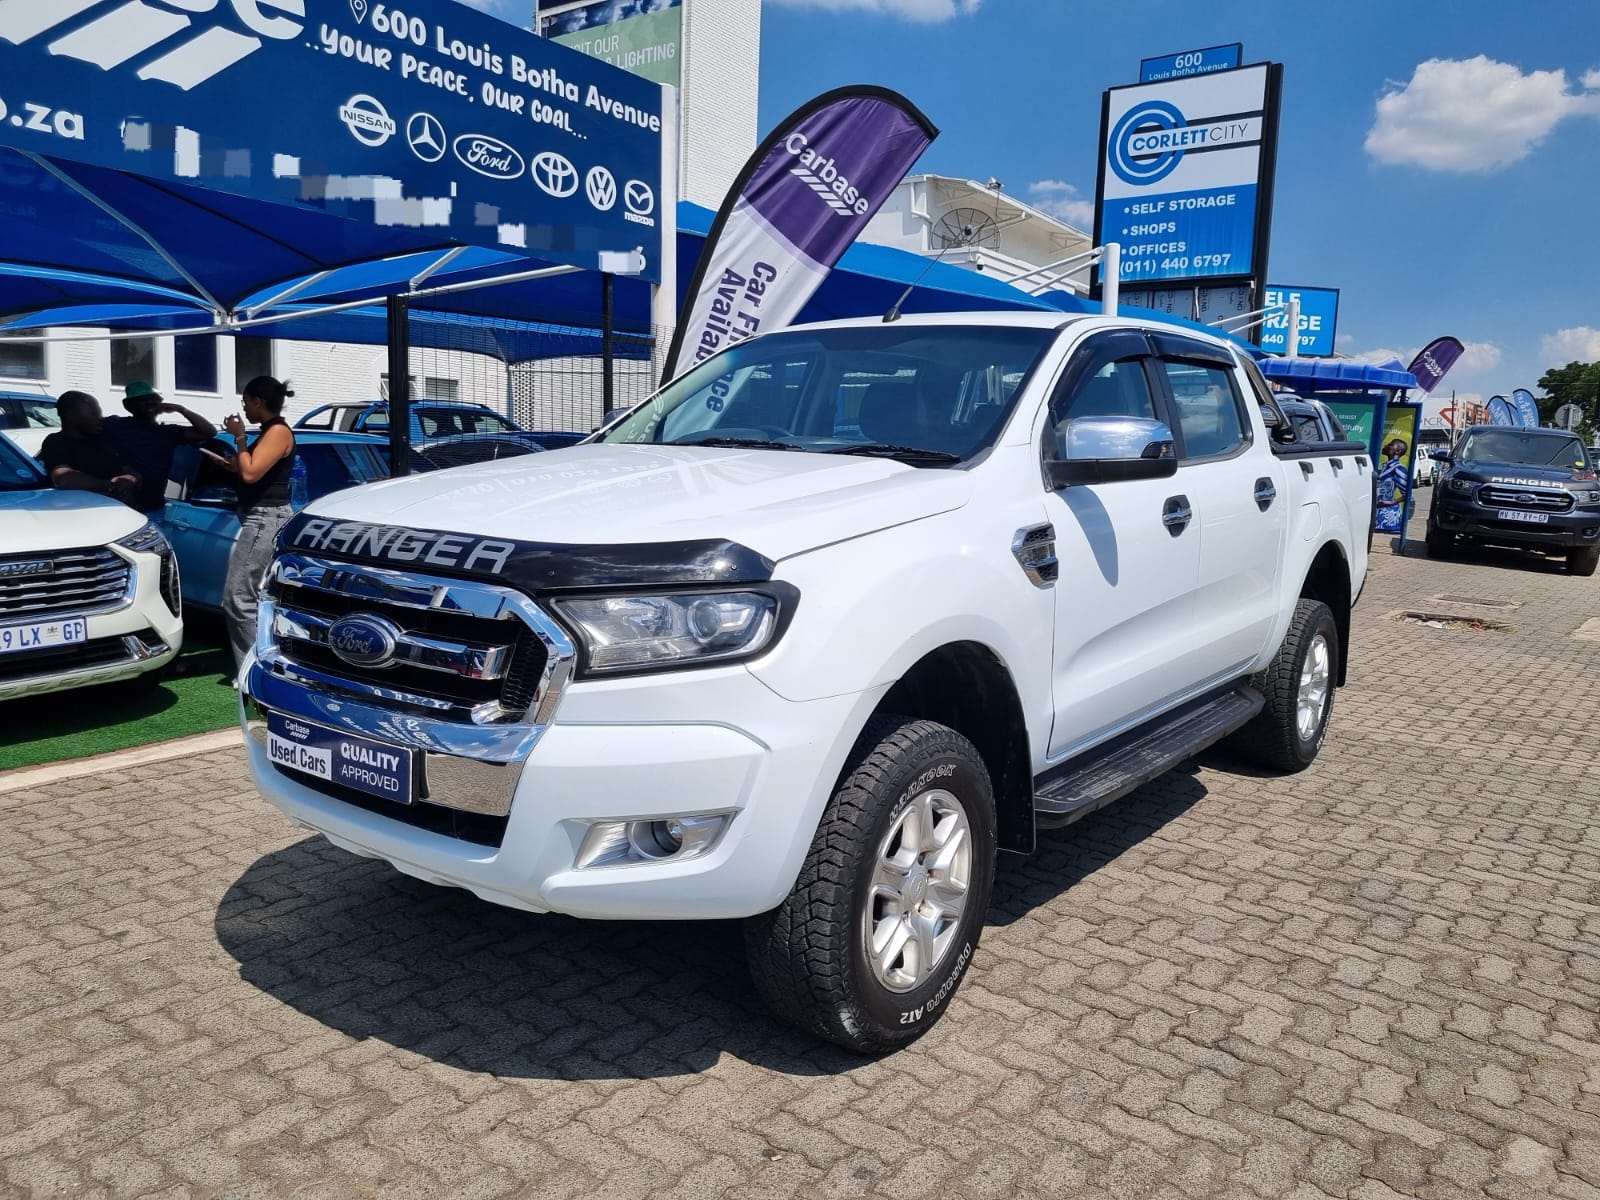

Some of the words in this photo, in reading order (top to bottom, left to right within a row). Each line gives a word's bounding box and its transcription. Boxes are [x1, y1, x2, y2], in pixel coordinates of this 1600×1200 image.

[594, 34, 620, 55] OUR
[616, 42, 676, 69] LIGHTING
[371, 4, 427, 46] 600
[436, 25, 503, 75] Louis
[511, 54, 579, 103] Botha
[584, 84, 662, 133] Avenue
[1149, 72, 1170, 81] Louis
[1171, 67, 1196, 77] Botha
[1196, 62, 1228, 73] Avenue
[1175, 52, 1203, 69] 600
[482, 81, 525, 116] OUR
[343, 109, 393, 132] NISSAN
[467, 140, 513, 171] Ford
[785, 133, 869, 216] Carbase
[1131, 202, 1165, 215] SELF
[1169, 194, 1237, 212] STORAGE
[1130, 221, 1176, 236] SHOPS
[1128, 241, 1187, 257] OFFICES
[1119, 259, 1157, 275] (011)
[1160, 256, 1189, 270] 440
[1193, 253, 1232, 268] 6797
[746, 261, 778, 309] Car
[1492, 477, 1564, 487] RANGER
[293, 518, 516, 574] RANGER
[20, 627, 42, 647] LX
[63, 622, 83, 641] GP
[337, 626, 374, 654] Ford
[284, 719, 311, 735] Carbase
[270, 738, 297, 764] Used
[299, 746, 327, 774] Cars
[340, 741, 400, 773] QUALITY
[341, 764, 400, 792] APPROVED
[899, 1005, 924, 1024] AT2
